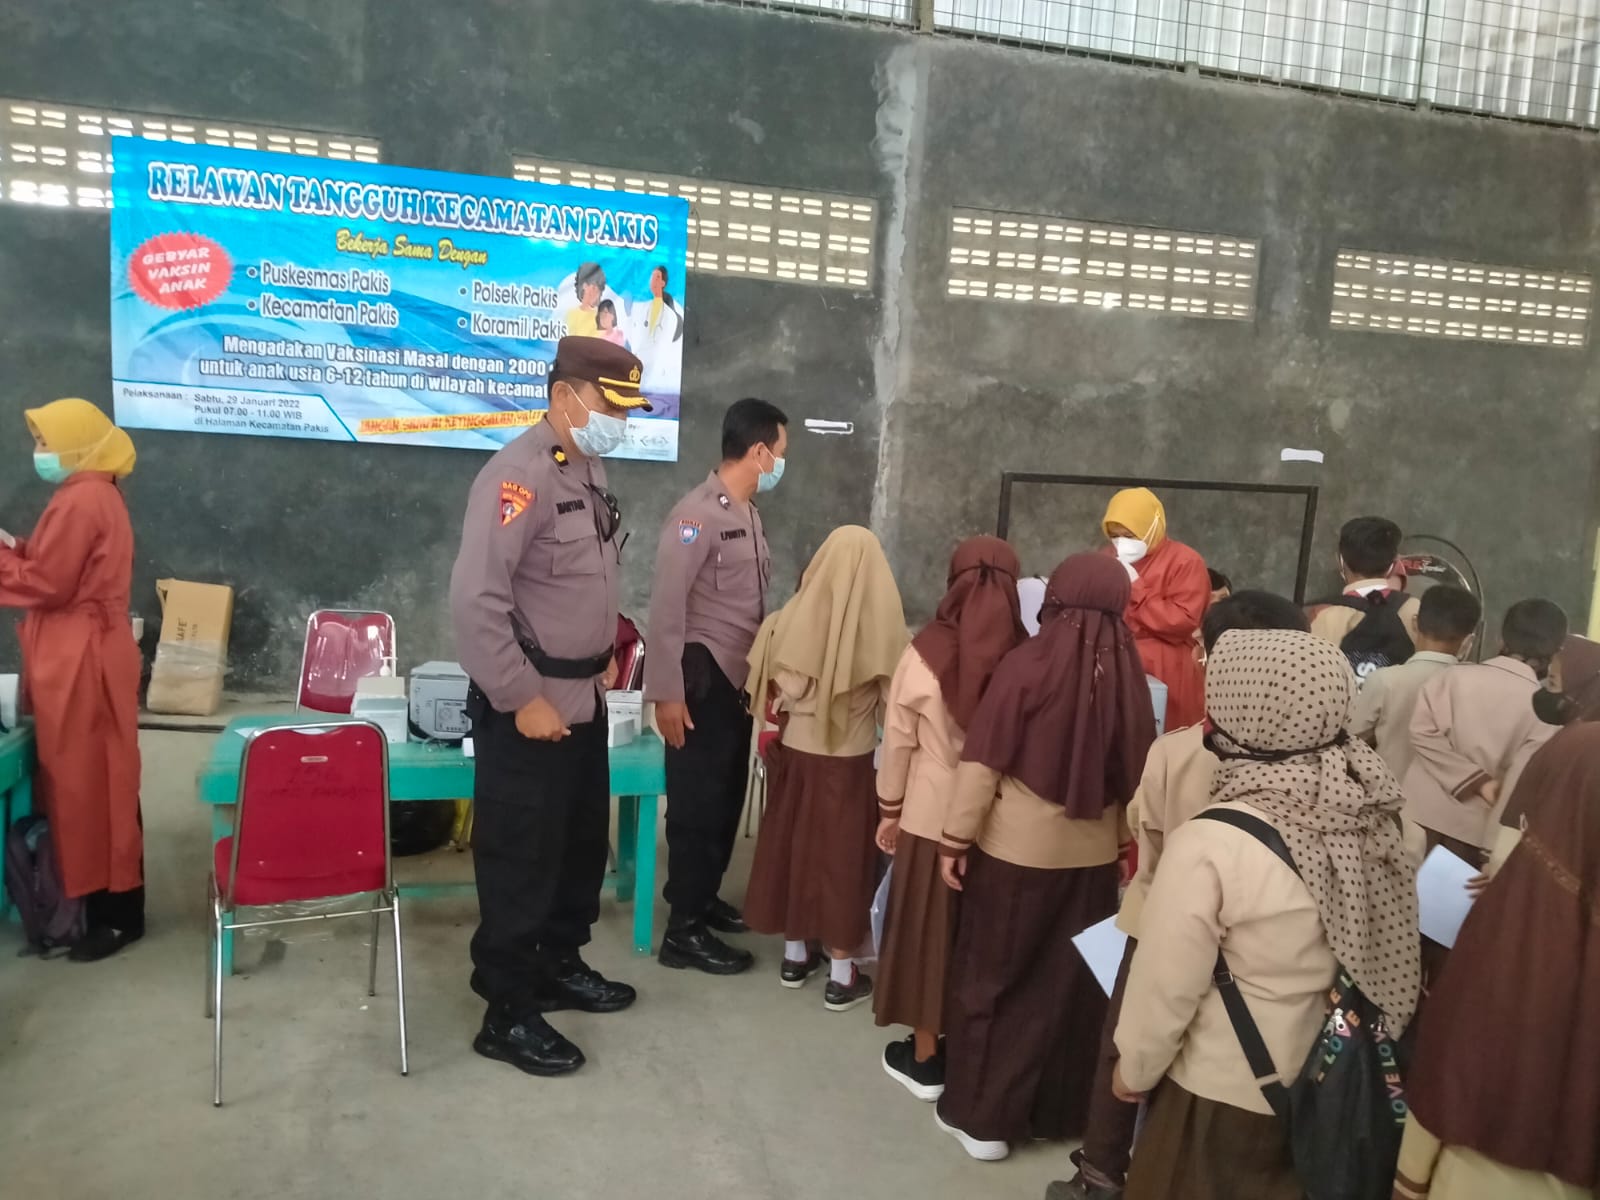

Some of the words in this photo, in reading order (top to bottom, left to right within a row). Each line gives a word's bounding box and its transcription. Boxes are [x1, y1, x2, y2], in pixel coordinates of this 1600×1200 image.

[148, 162, 283, 210] RELAWAN
[290, 176, 419, 226] TANGGUH
[423, 191, 582, 242] KECAMATAN
[585, 208, 658, 250] PAKIS
[142, 247, 210, 265] GEBYAR
[336, 228, 388, 259] Bekerja
[393, 234, 433, 259] Sama
[438, 237, 487, 269] Dengan
[148, 262, 211, 279] VAKSIN
[262, 263, 345, 288] Puskesmas
[351, 269, 389, 293] Pakis
[159, 278, 207, 294] ANAK
[473, 282, 519, 305] Polsek
[523, 286, 558, 308] Pakis
[262, 299, 356, 322] Kecamatan
[360, 304, 397, 326] Pakis
[473, 317, 527, 336] Koramil
[532, 322, 567, 339] Pakis
[223, 335, 323, 361] Mengadakan
[327, 343, 400, 365] Vaksinasi
[403, 351, 448, 369] Masal
[452, 354, 503, 374] dengan
[508, 358, 546, 376] 2000
[200, 358, 242, 376] untuk
[249, 362, 285, 380] anak
[289, 365, 321, 382] usia
[325, 367, 362, 386] 6-12
[365, 370, 407, 387] tahun
[411, 372, 425, 389] di
[428, 374, 484, 395] wilayah
[487, 377, 548, 398] kecamat
[123, 388, 182, 400] Pelaksanaan
[194, 393, 224, 404] Sabtu,
[227, 395, 237, 404] 29
[240, 396, 275, 407] Januari
[278, 398, 300, 408] 2022
[194, 405, 220, 414] Pukul
[223, 406, 248, 417] 07.00
[257, 409, 280, 418] 11.00
[283, 411, 302, 419] WIB
[194, 417, 201, 425] di
[206, 418, 246, 427] Halaman
[249, 420, 301, 430] Kecamatan
[304, 423, 329, 433] Pakis
